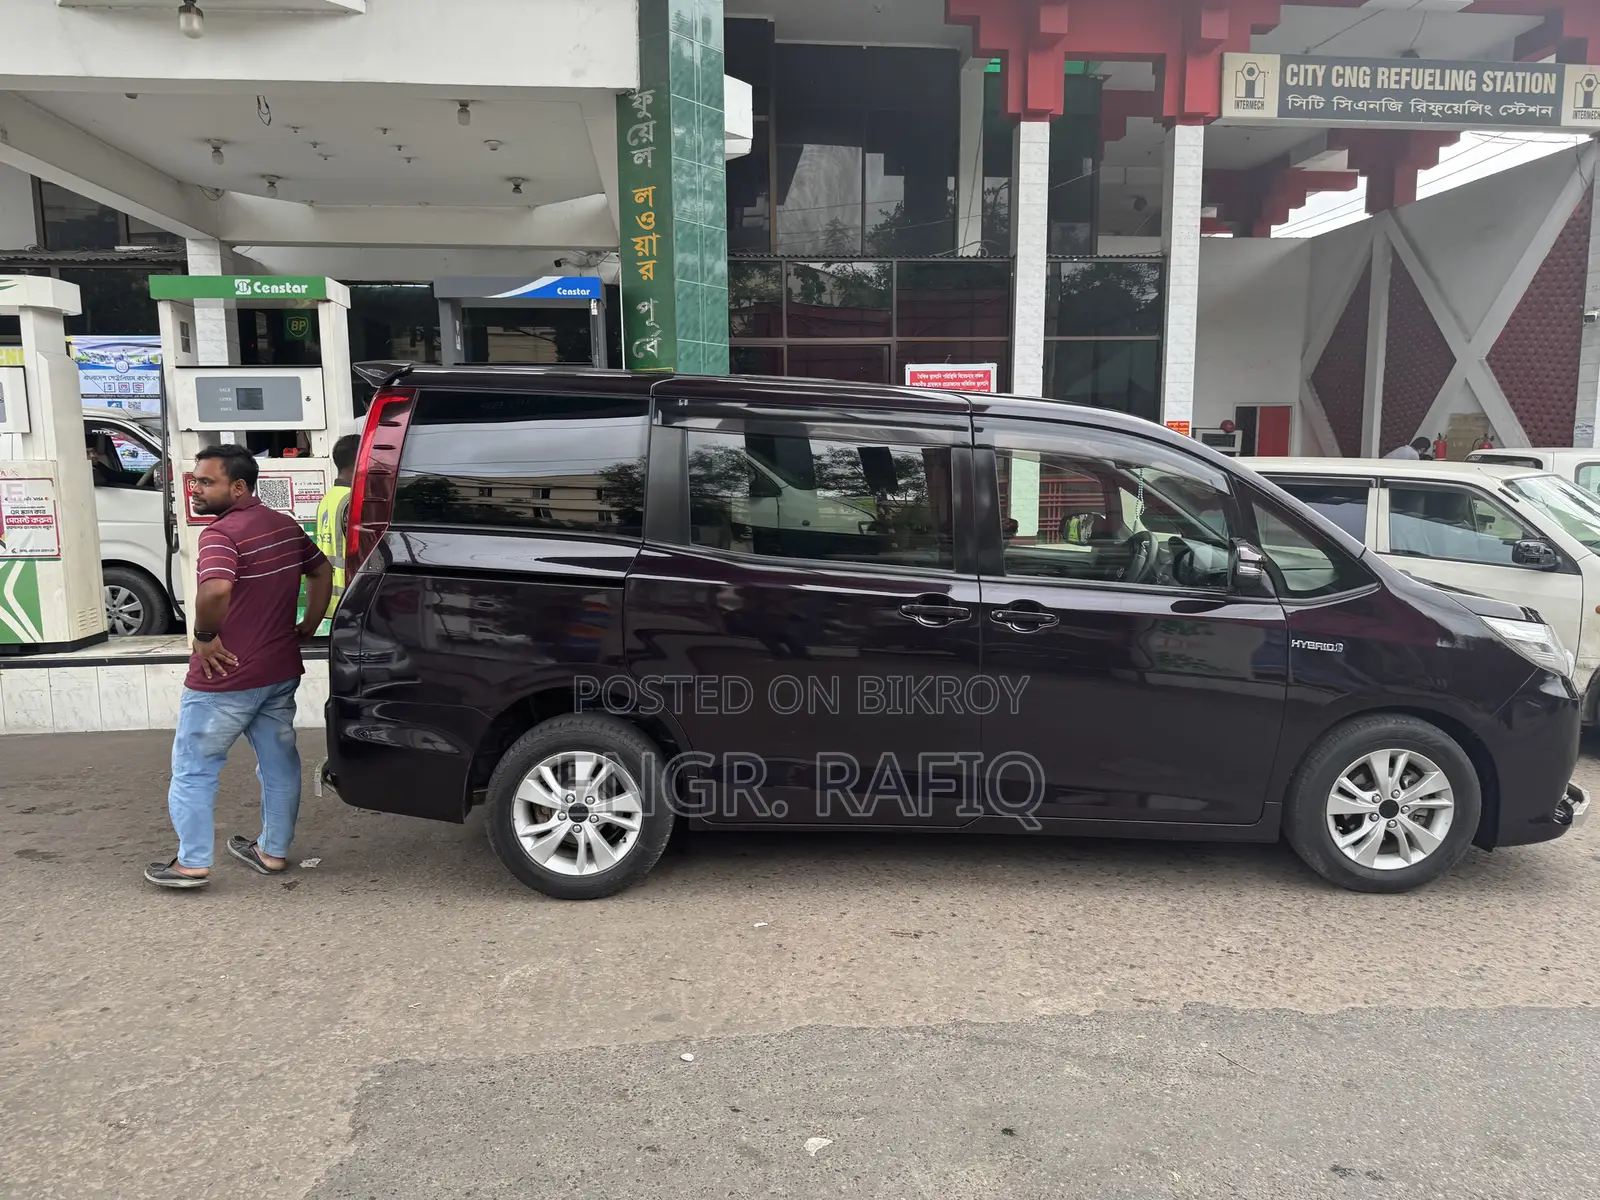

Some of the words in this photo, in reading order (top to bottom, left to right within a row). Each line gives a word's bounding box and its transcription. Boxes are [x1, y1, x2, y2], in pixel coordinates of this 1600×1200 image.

[1285, 63, 1327, 87] CITY
[1331, 65, 1371, 89] CNG
[1376, 67, 1477, 92] REFUELING
[1482, 70, 1557, 95] STATION
[1234, 99, 1265, 111] INTERMECH
[1286, 94, 1327, 111] সিটি
[1332, 95, 1402, 113] সিএনজি
[1409, 98, 1493, 118] রিফুয়েলিং
[1499, 101, 1554, 118] স্টেশন
[253, 281, 309, 294] Censtar
[556, 287, 591, 296] Censtar
[291, 320, 306, 331] BP
[1291, 639, 1336, 652] HYBRID
